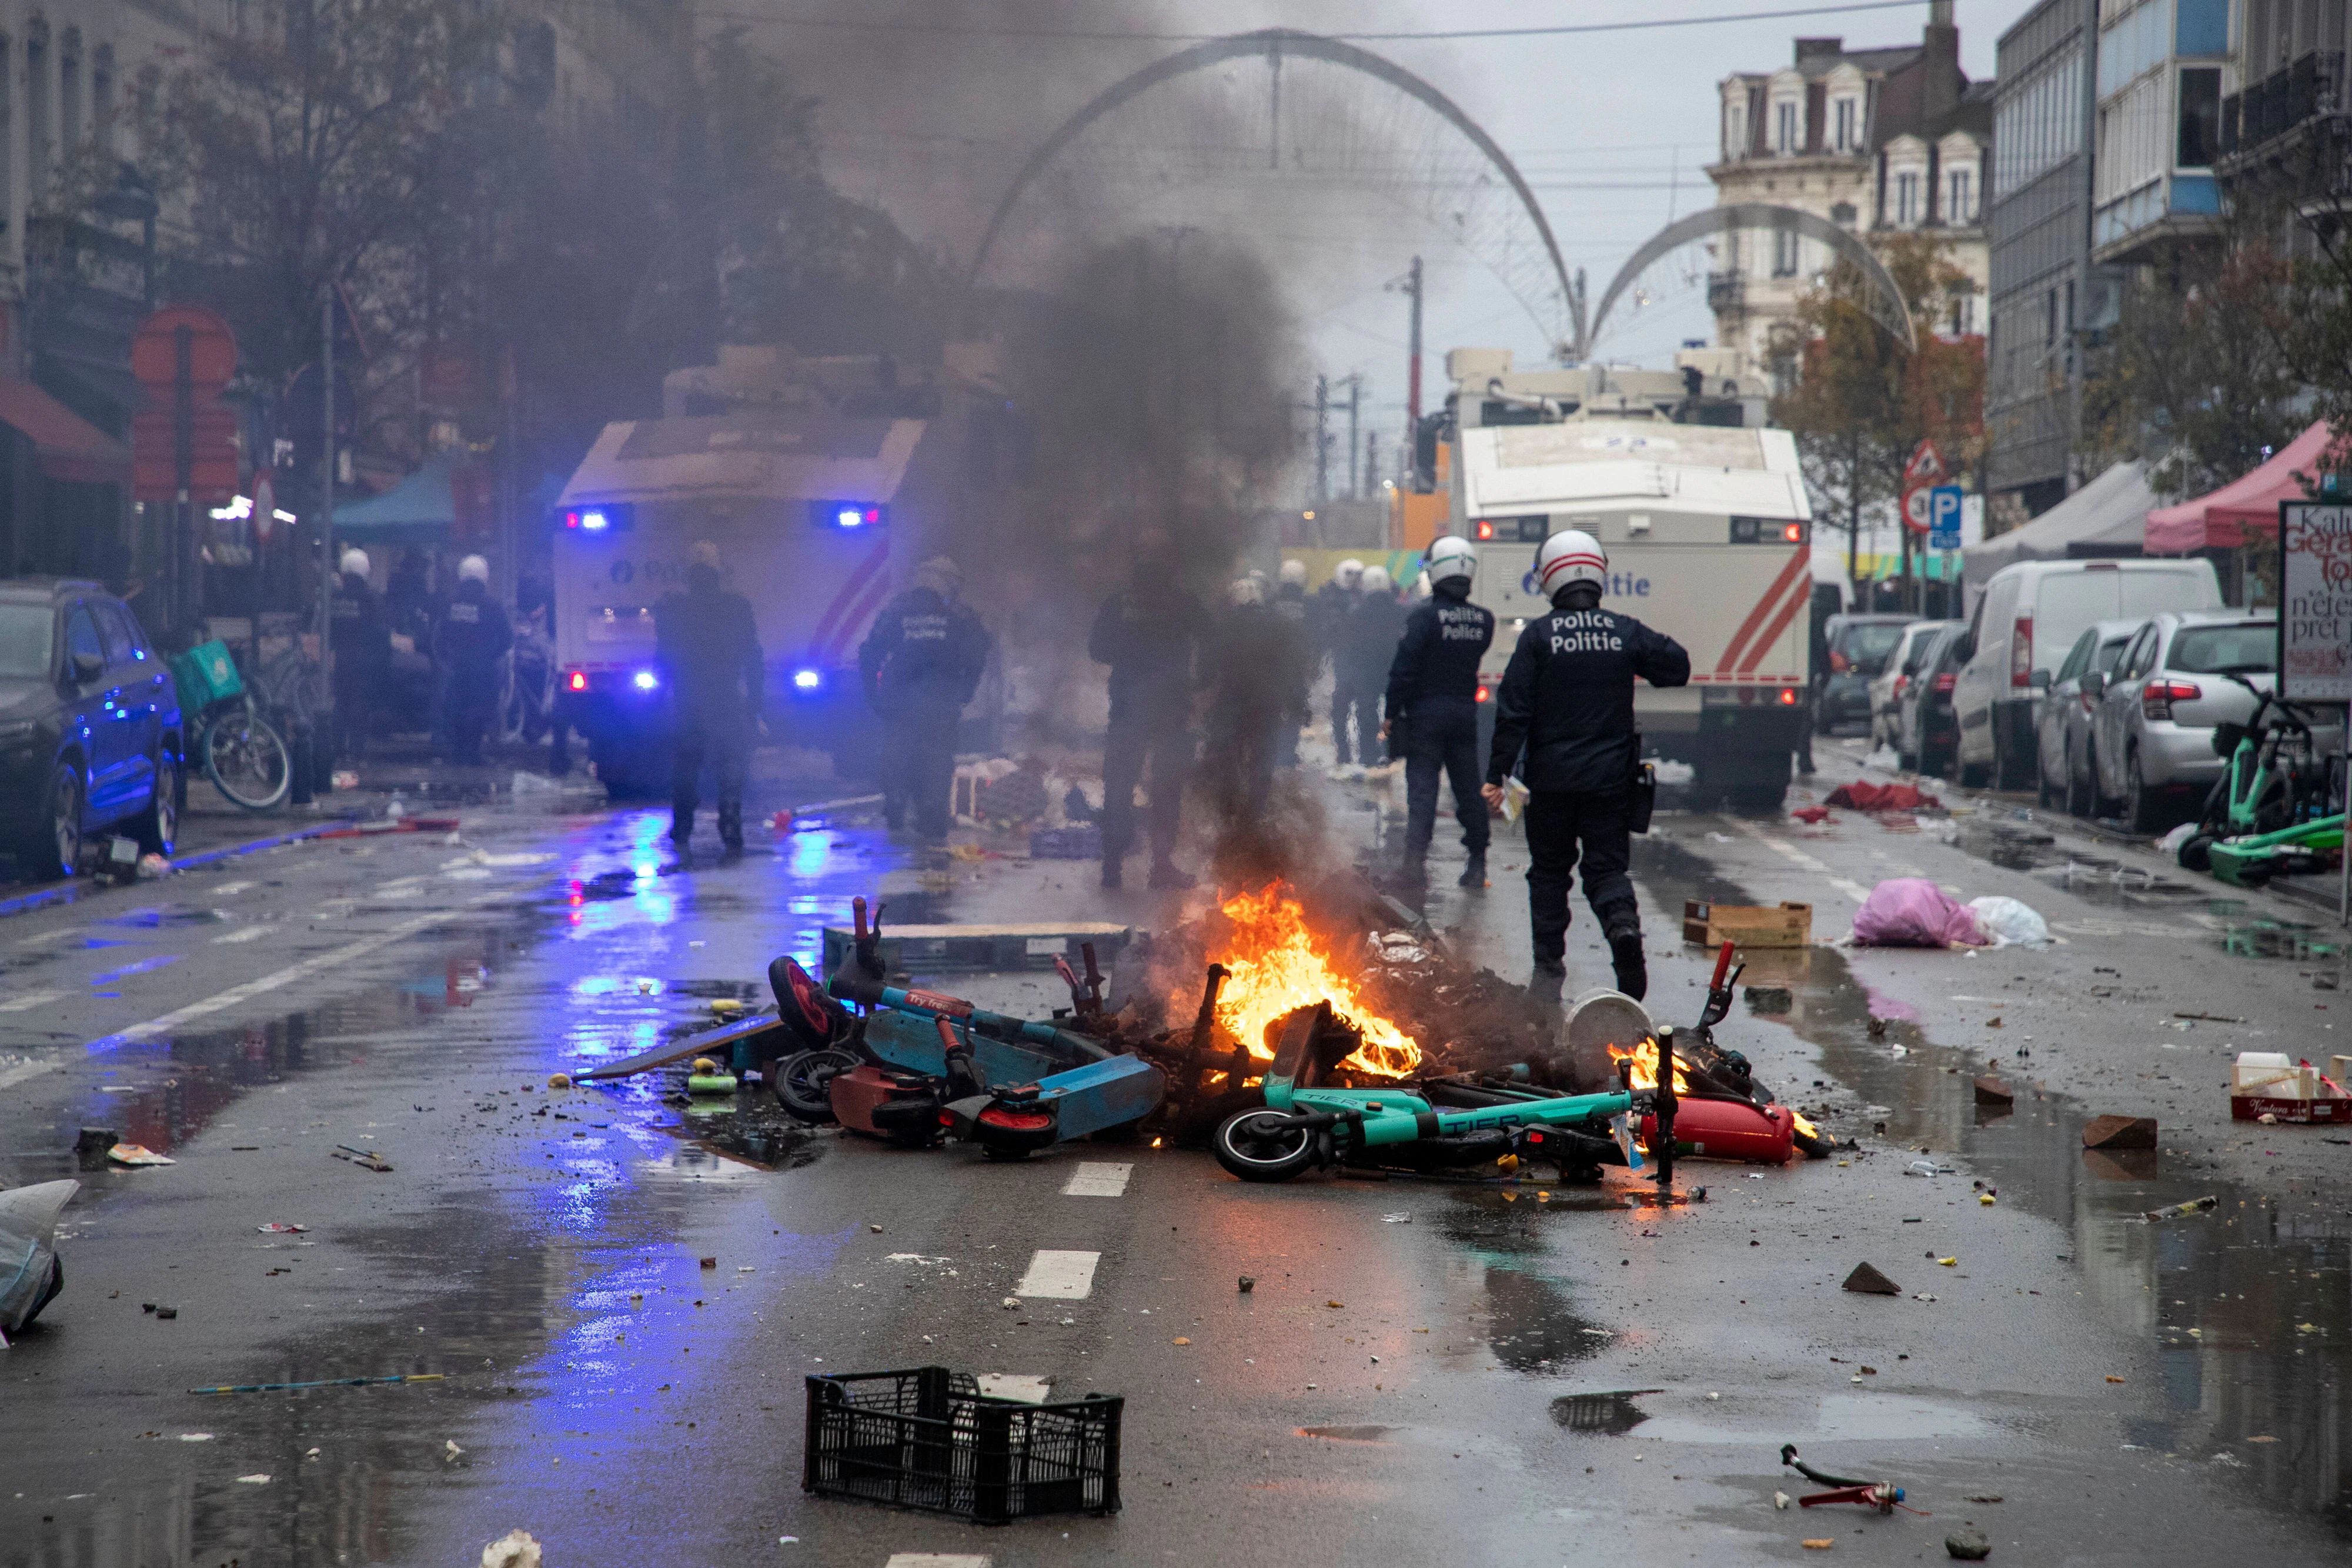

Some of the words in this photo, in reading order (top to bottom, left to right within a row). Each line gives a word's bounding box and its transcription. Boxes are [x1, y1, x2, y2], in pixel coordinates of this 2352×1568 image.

[1934, 493, 1957, 527] P
[2314, 553, 2352, 580] To
[1603, 571, 1651, 597] itie
[2293, 590, 2352, 616] n'ête
[1438, 607, 1485, 623] Politie
[1551, 610, 1615, 632] Police
[1442, 623, 1484, 640] Police
[1550, 631, 1623, 654] Politie
[909, 994, 926, 1007] Try
[1304, 1094, 1358, 1106] TIER
[2249, 1098, 2288, 1114] Ventura
[1444, 1114, 1520, 1133] TIER
